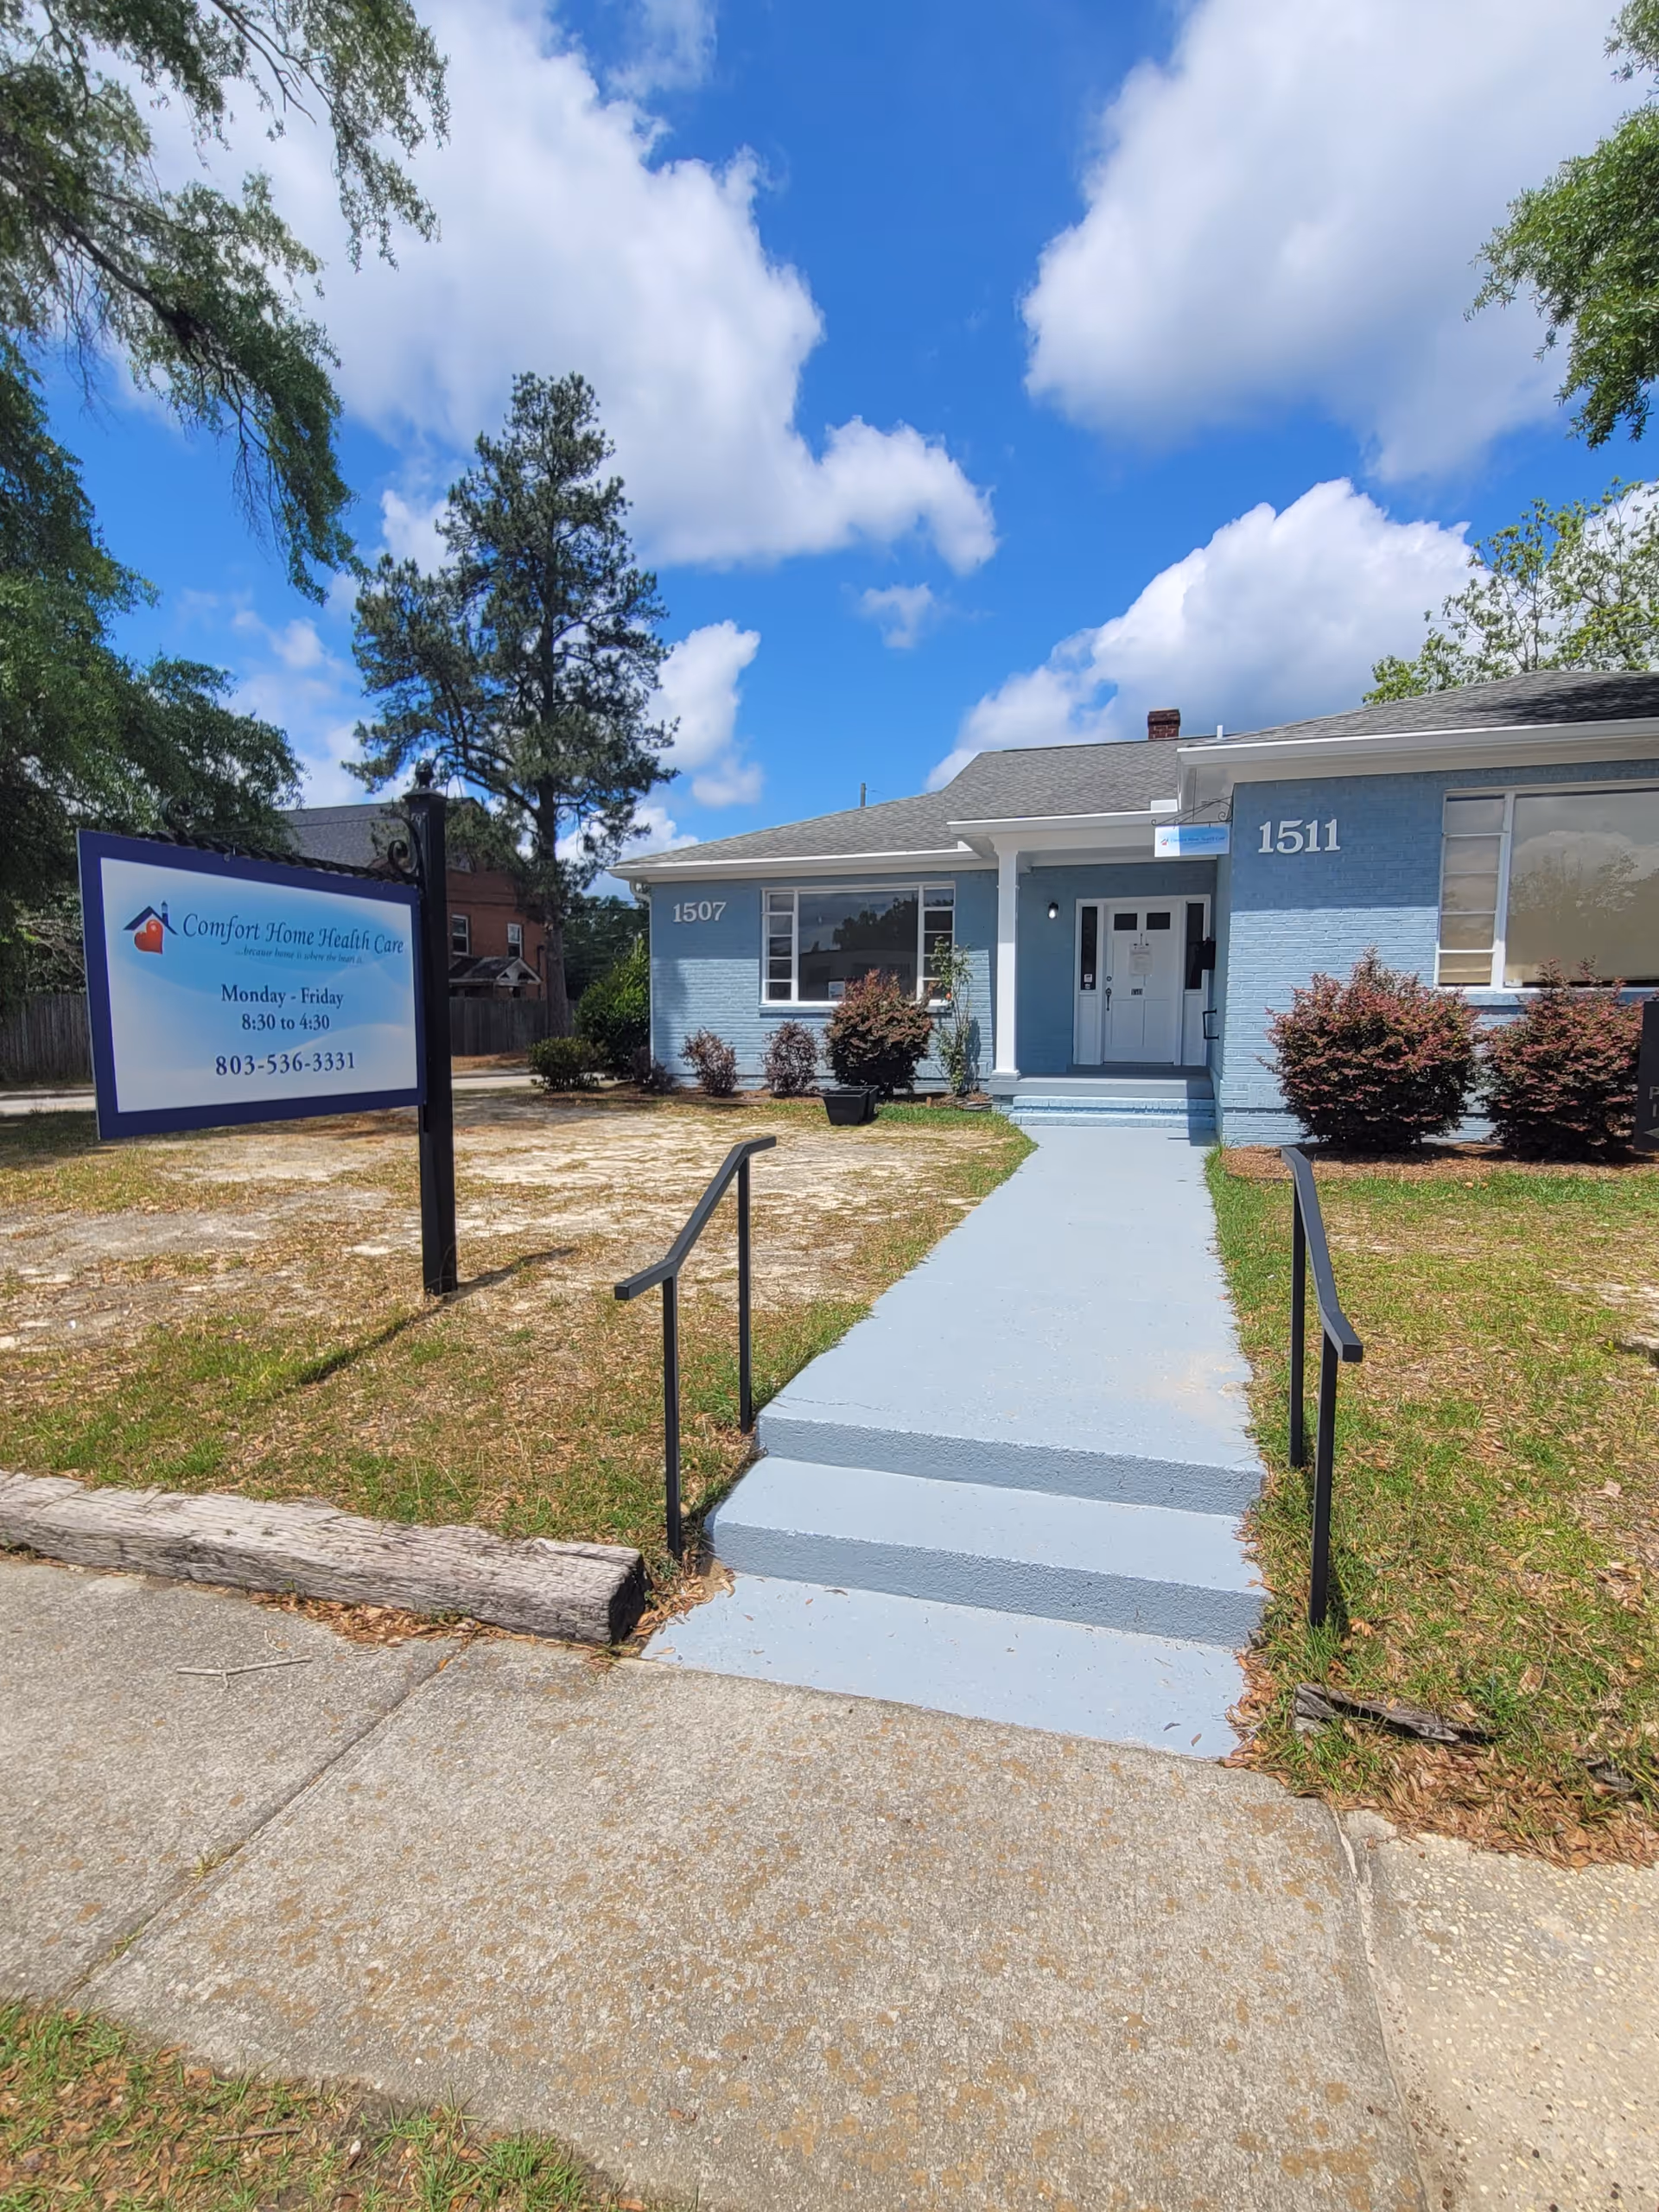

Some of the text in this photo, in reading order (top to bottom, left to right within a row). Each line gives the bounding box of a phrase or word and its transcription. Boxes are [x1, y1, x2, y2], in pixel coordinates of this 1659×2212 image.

[1258, 818, 1341, 854] 1511
[672, 900, 727, 923] 1507
[183, 912, 404, 955] Comfort Home Health Care
[221, 983, 286, 1008] Monday
[301, 987, 344, 1009] Friday
[241, 1012, 330, 1031] 8:30 to 4:30
[215, 1051, 355, 1076] 803-536-3331
